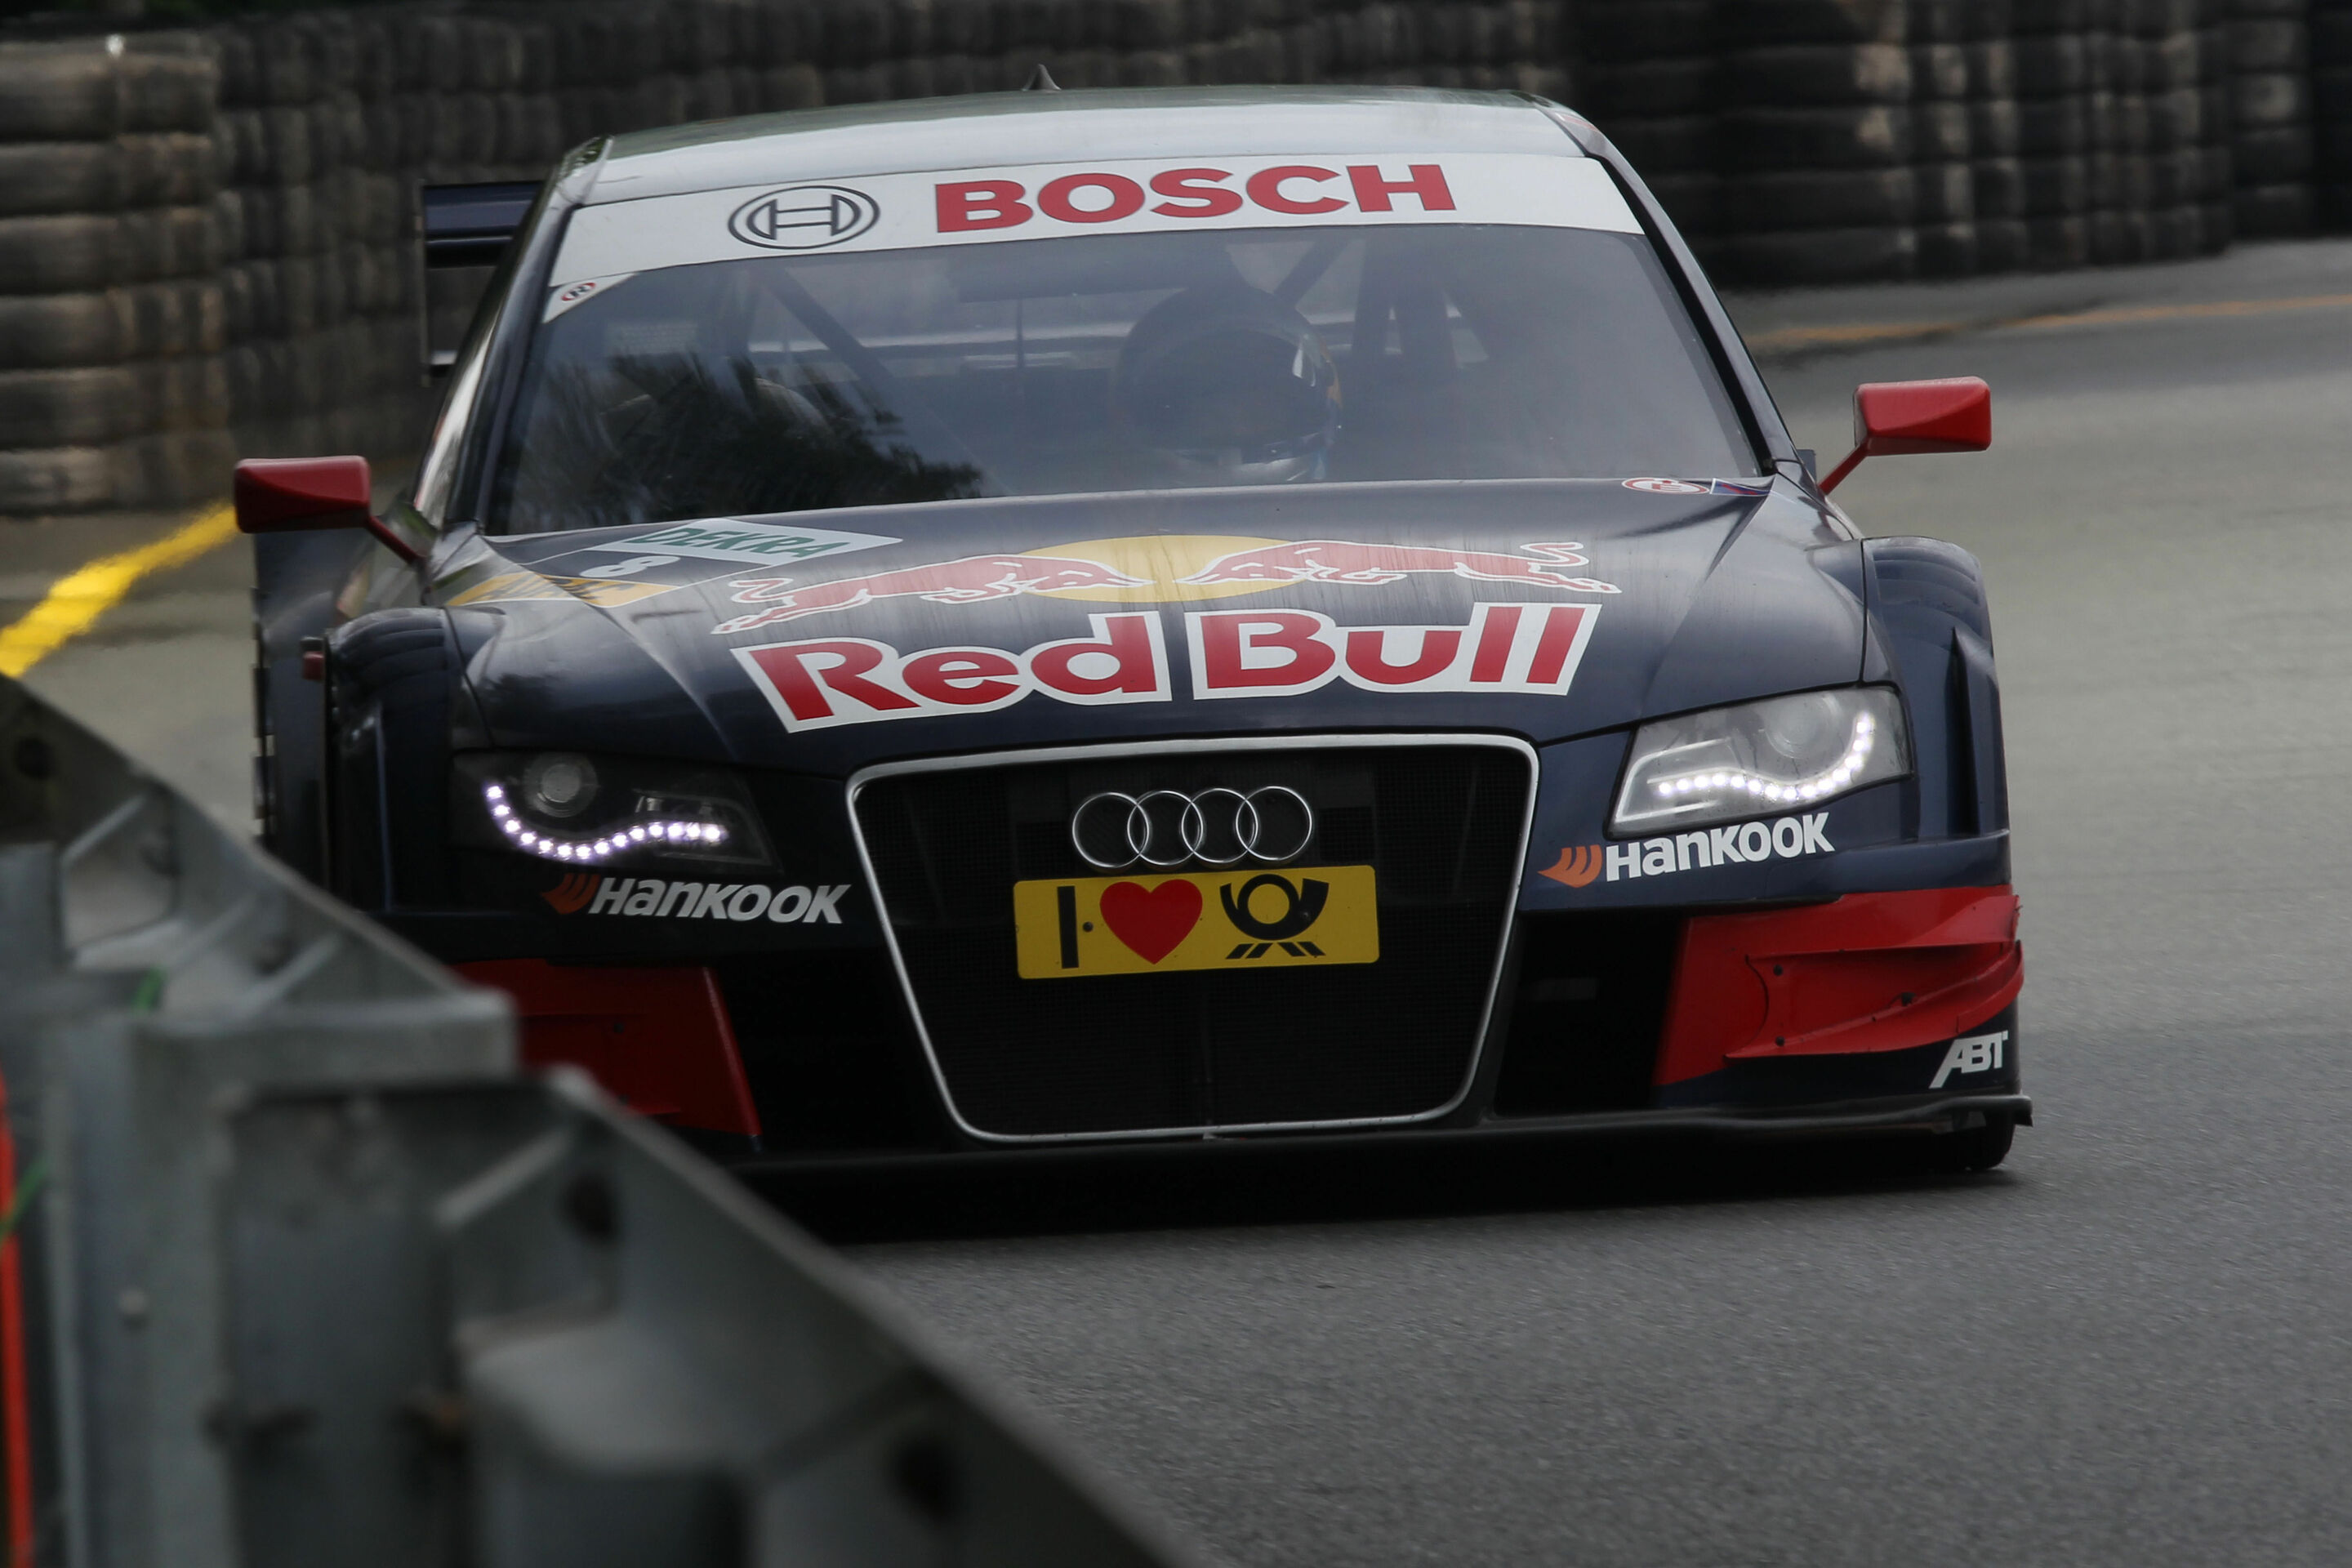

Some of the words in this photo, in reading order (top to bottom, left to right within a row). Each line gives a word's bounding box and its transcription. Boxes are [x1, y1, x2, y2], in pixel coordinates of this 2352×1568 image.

[935, 164, 1456, 233] BOSCH
[623, 528, 850, 557] DEKRA
[769, 616, 1156, 721] Red
[1200, 606, 1588, 692] Bull
[1928, 1030, 2009, 1089] ABT
